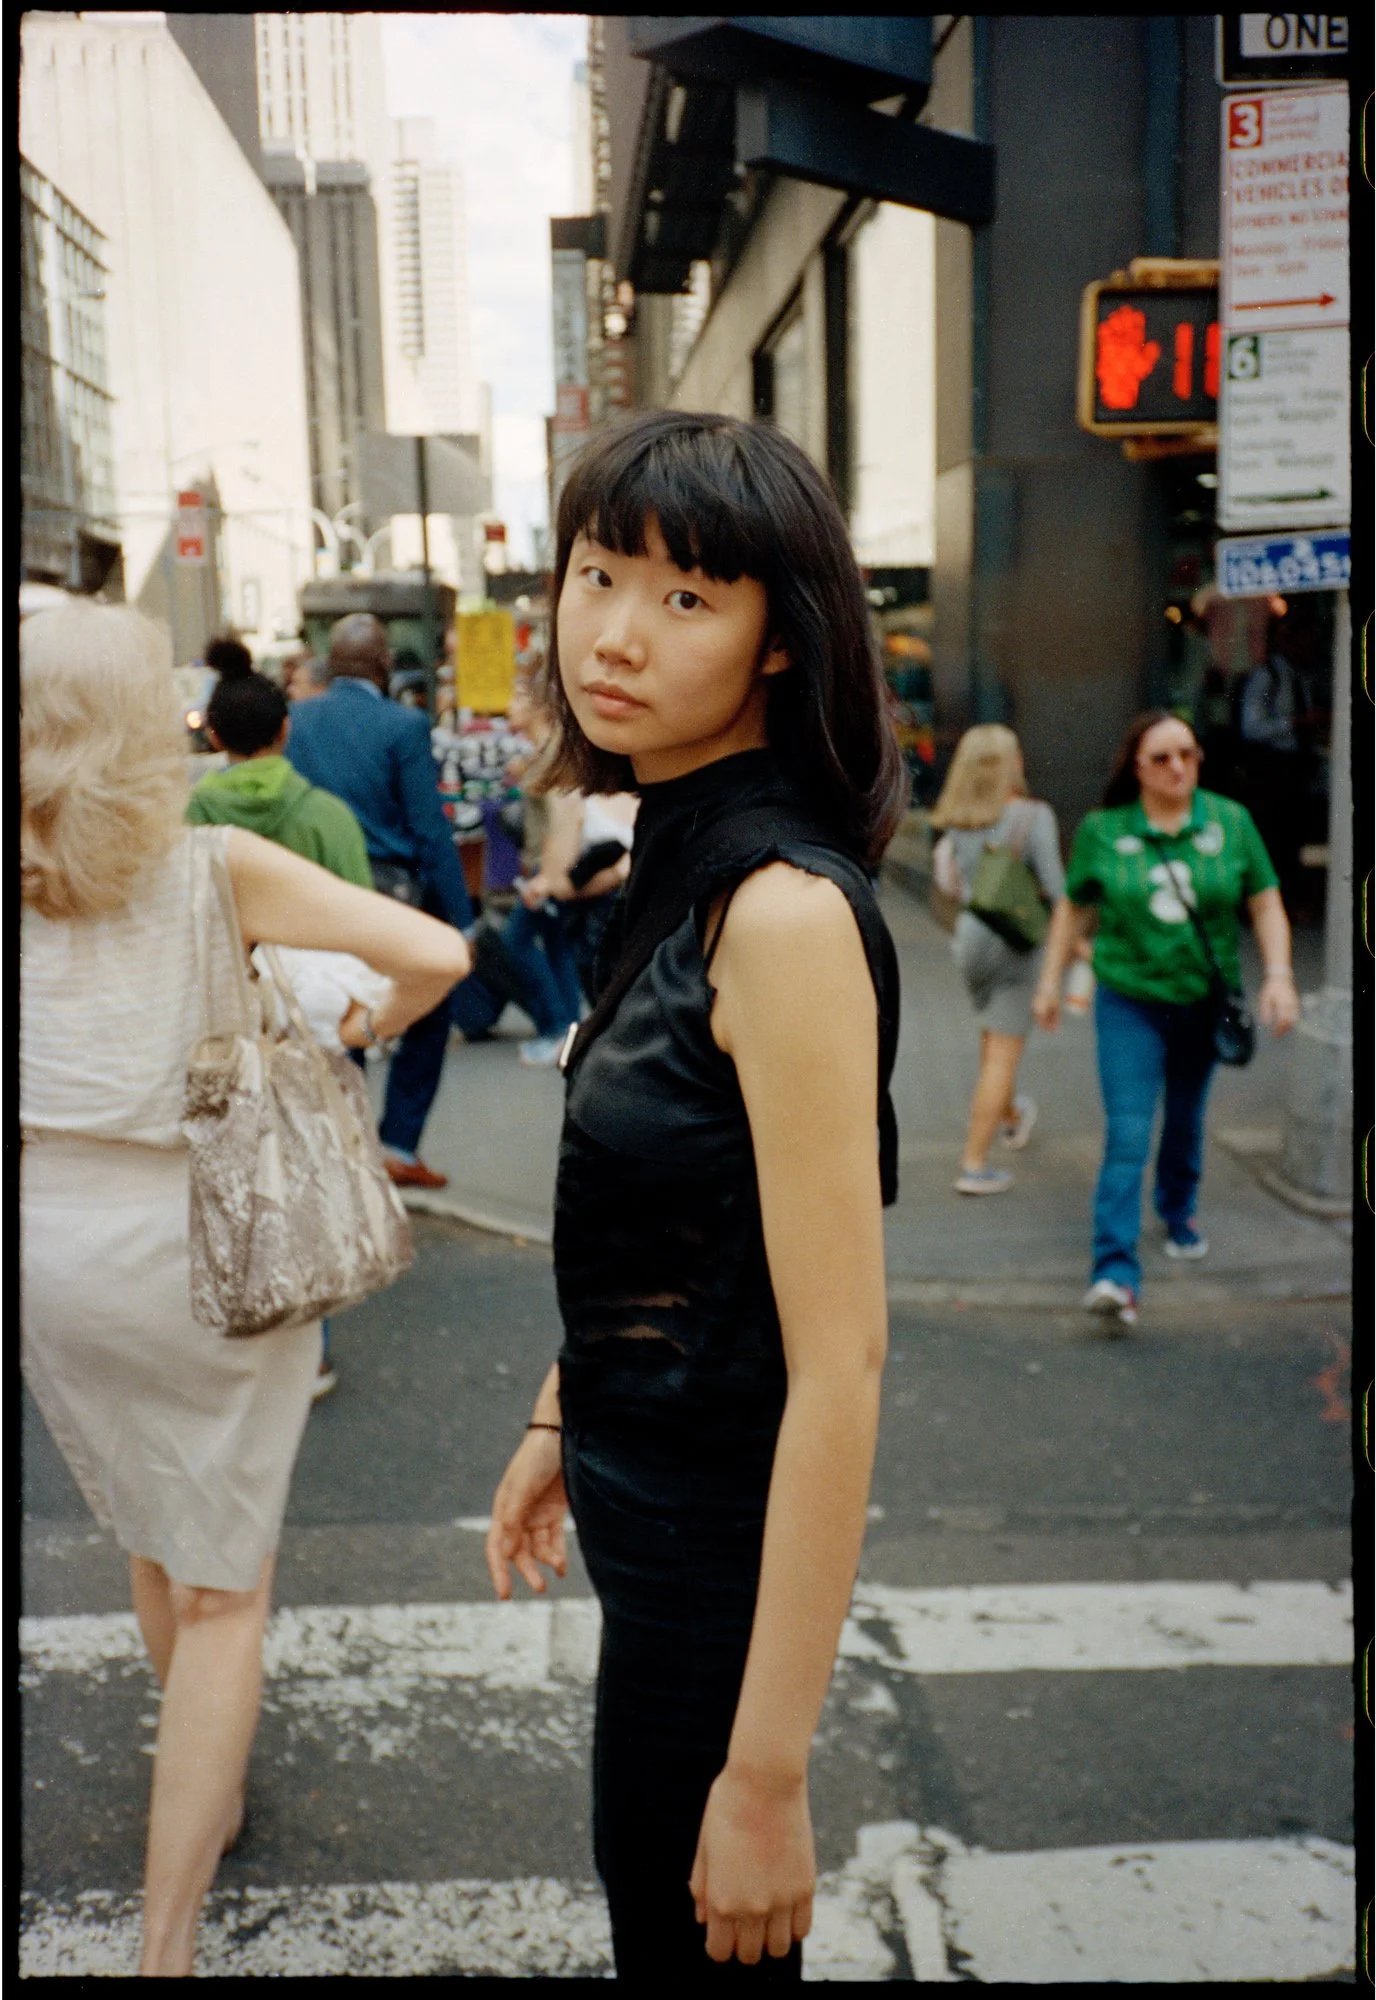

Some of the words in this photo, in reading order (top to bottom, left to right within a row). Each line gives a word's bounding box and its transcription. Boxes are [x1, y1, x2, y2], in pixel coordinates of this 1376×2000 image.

[1266, 13, 1348, 49] ONE
[1231, 104, 1260, 148] 3
[1231, 336, 1257, 379] 6
